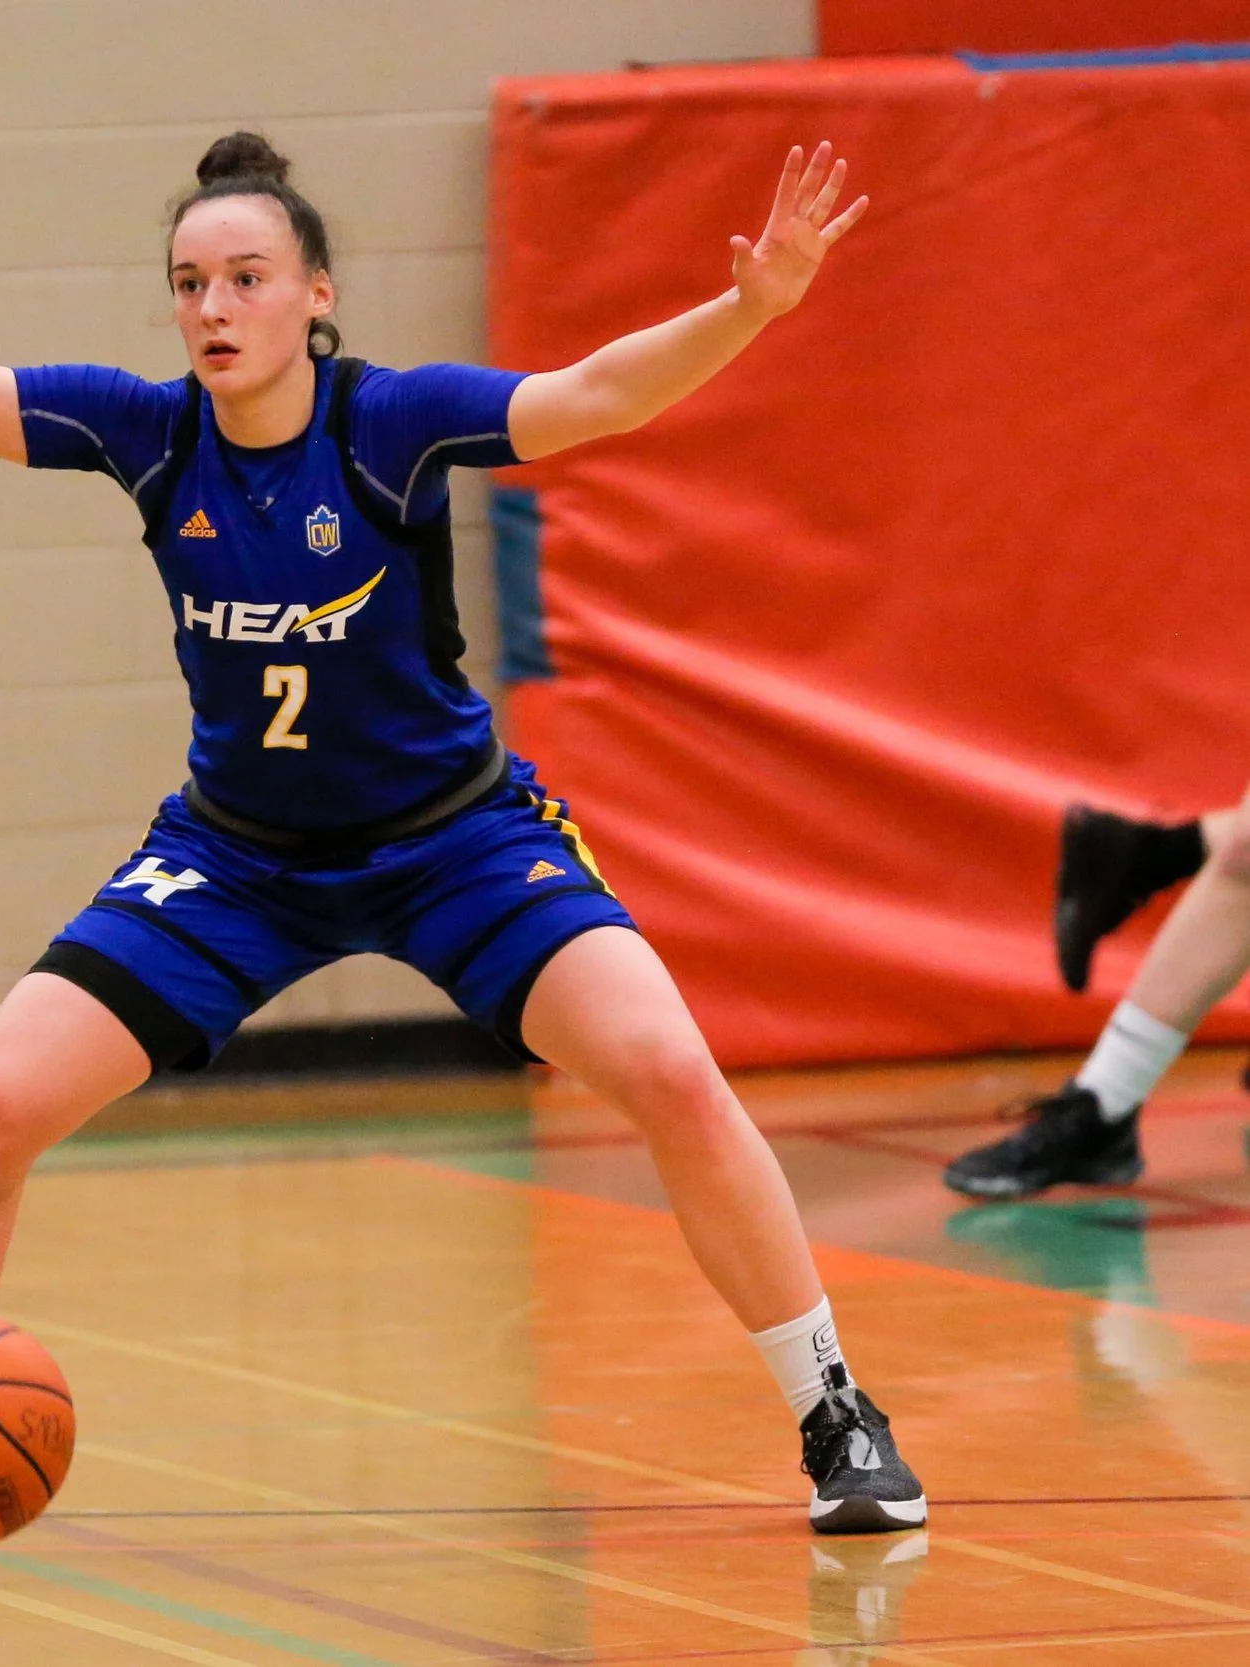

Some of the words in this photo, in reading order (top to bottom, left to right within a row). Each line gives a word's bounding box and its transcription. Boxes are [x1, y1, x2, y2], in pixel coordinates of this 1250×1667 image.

[180, 526, 217, 539] adidas
[310, 523, 336, 547] CW
[182, 578, 379, 642] HEAT
[262, 664, 308, 750] 2
[527, 868, 566, 882] adidas
